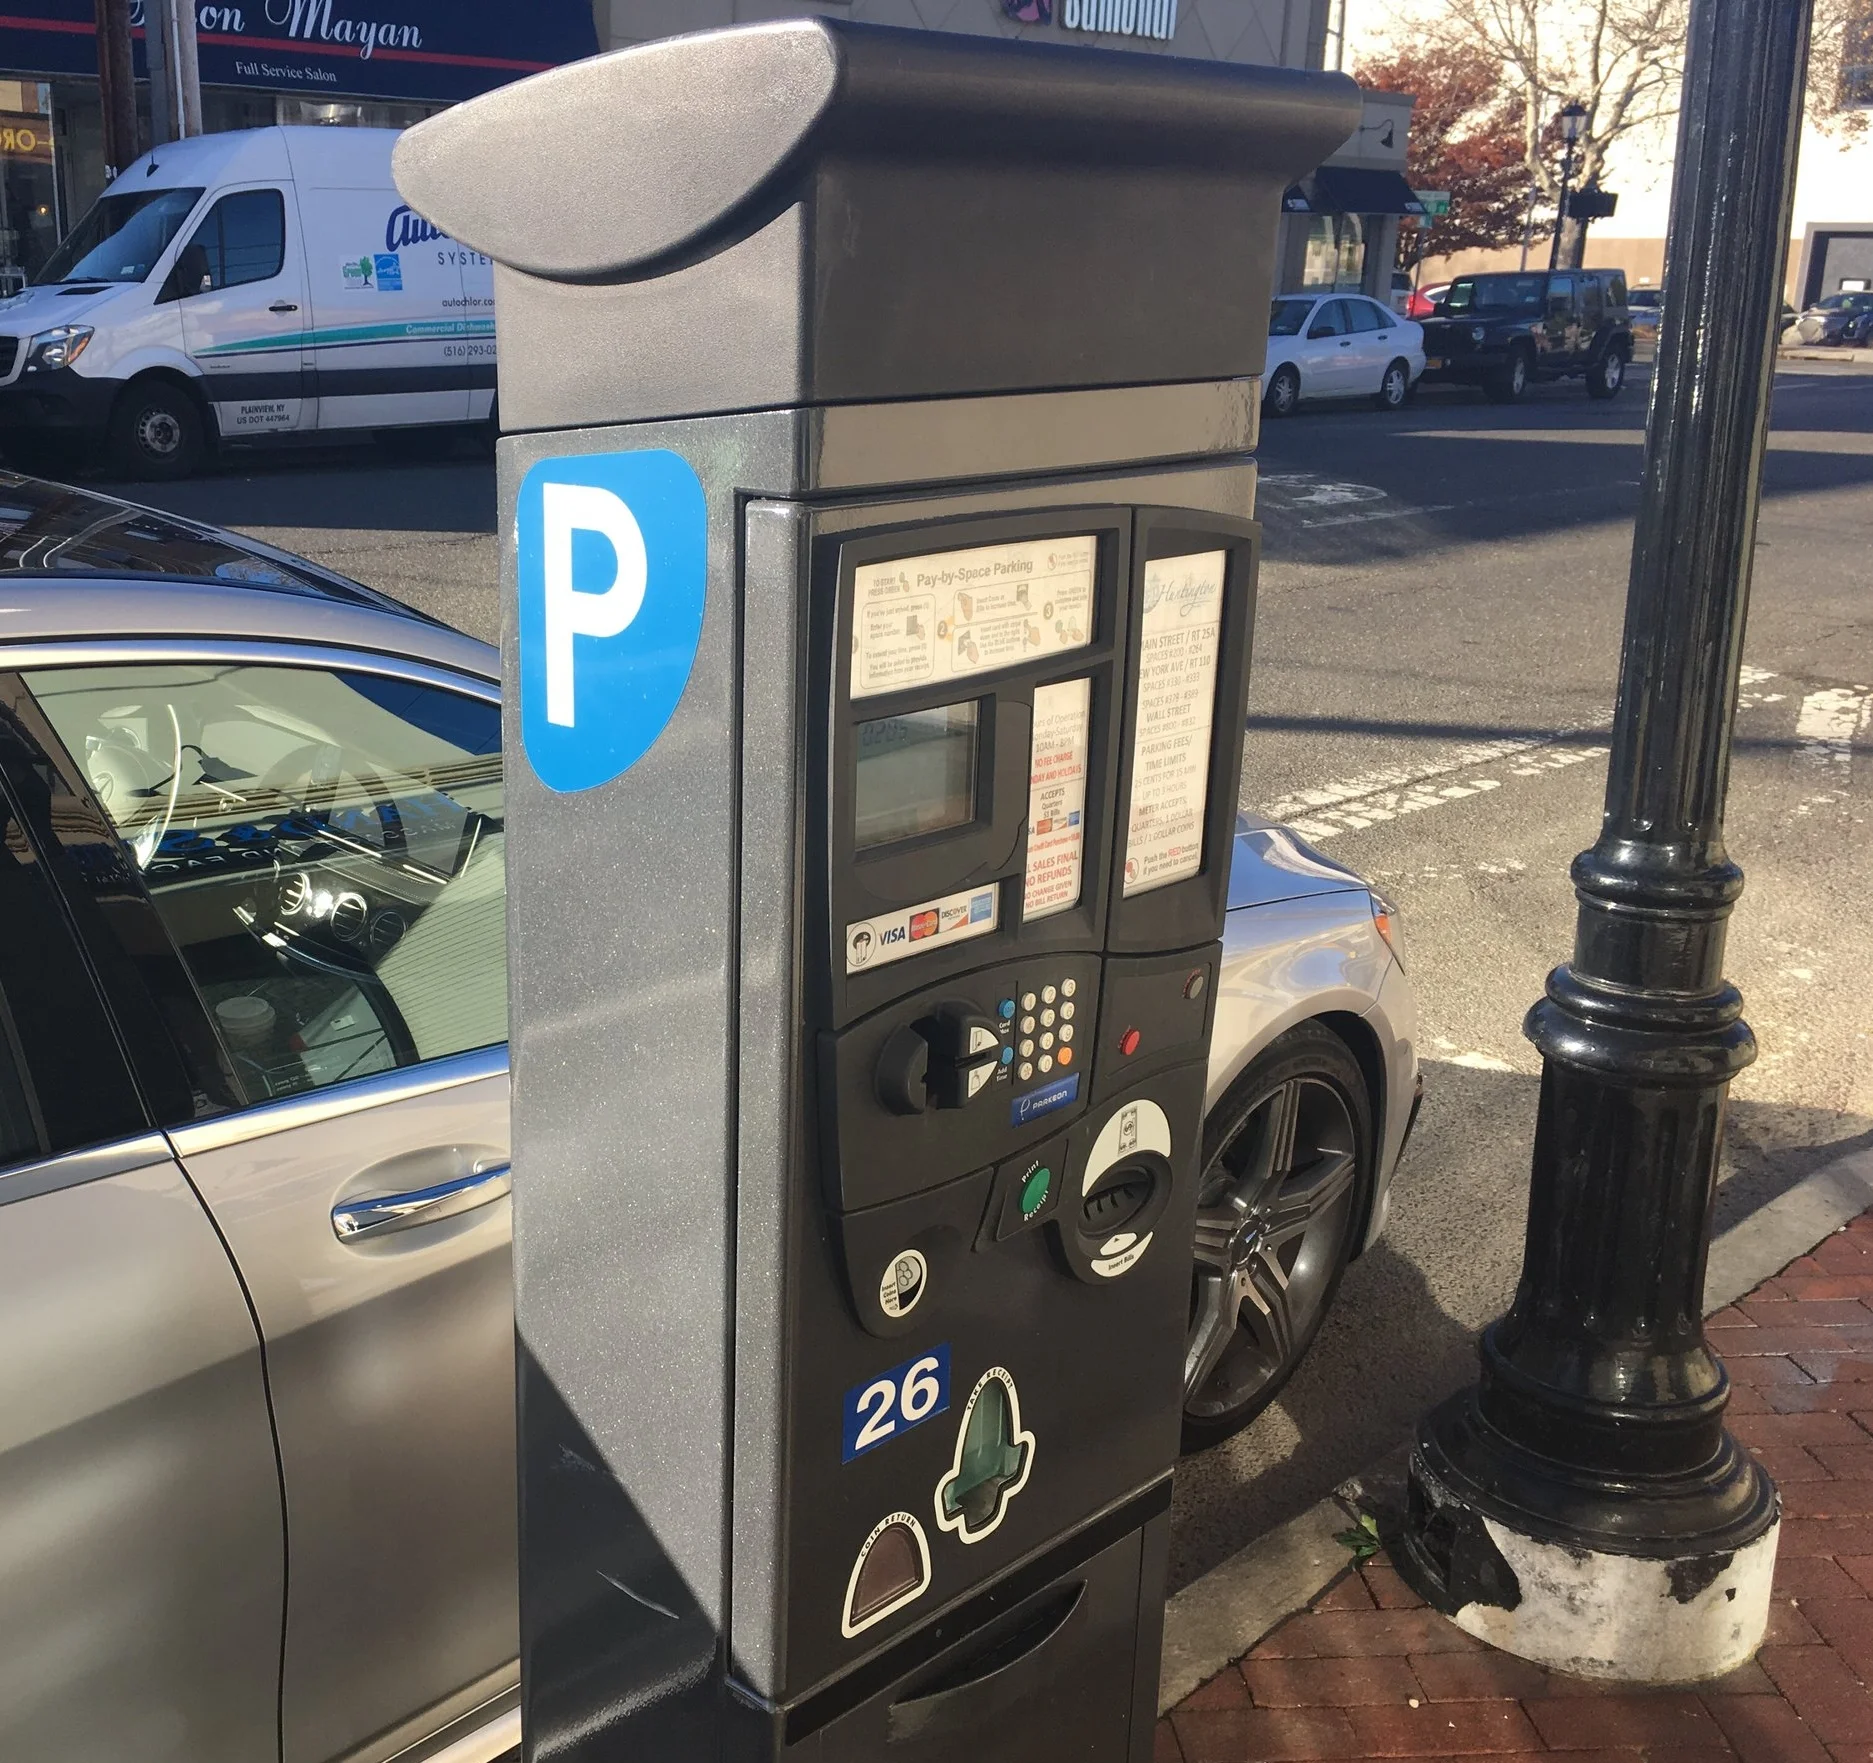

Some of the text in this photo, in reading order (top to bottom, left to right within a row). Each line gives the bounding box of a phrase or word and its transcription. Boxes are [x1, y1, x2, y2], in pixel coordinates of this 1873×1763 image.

[265, 0, 423, 60] Mayan
[235, 61, 337, 83] Full Service Salon
[405, 322, 455, 335] Commercial
[443, 346, 466, 357] (516)
[276, 403, 286, 412] NY
[236, 417, 248, 425] US
[248, 415, 264, 424] DOT
[917, 559, 1034, 588] Pay-by-Space Parking
[543, 482, 648, 728] P
[1160, 579, 1217, 618] Huntington
[1159, 632, 1185, 649] STREET
[1191, 629, 1201, 642] RT
[1201, 626, 1216, 640] 25A
[1146, 649, 1168, 664] SPACES
[1150, 662, 1170, 677] YORK
[1170, 660, 1184, 673] AVE
[1190, 657, 1199, 669] RT
[1199, 654, 1212, 667] 110
[1144, 678, 1166, 693] SPACES
[1142, 694, 1165, 710] SPACES
[1046, 714, 1055, 727] of
[1054, 709, 1086, 726] Operation
[1146, 703, 1192, 723] WALL STREET
[1139, 724, 1161, 737] SPACES
[1036, 740, 1056, 754] 10AM
[1141, 733, 1193, 756] PARKING FEES/
[1035, 750, 1074, 769] NO FEE CHARGE
[1145, 751, 1187, 773] TIME LIMITS
[1046, 769, 1058, 781] AND
[1056, 763, 1083, 778] HOLIDAYS
[1142, 772, 1162, 786] CENTS
[1162, 769, 1176, 781] FOR
[1176, 766, 1184, 778] 15
[1040, 786, 1066, 801] ACCEPTS
[1142, 788, 1152, 801] UP
[1152, 786, 1161, 798] TO
[1166, 779, 1188, 793] HOURS
[1041, 799, 1064, 811] Quarters
[1138, 802, 1161, 817] METER
[1170, 807, 1194, 823] DOLLAR
[1128, 835, 1144, 850] BILLS
[1153, 826, 1178, 842] DOLLAR
[1177, 821, 1196, 835] COINS
[1032, 856, 1056, 872] SALES
[1056, 850, 1079, 866] FINAL
[1143, 843, 1199, 866] Push the RED button
[1037, 864, 1073, 885] REFUNDS
[1148, 864, 1159, 877] you
[1158, 860, 1173, 871] need
[1031, 884, 1055, 899] CHANGE
[1055, 879, 1073, 892] GIVEN
[1026, 890, 1069, 909] NO BILL RETURN
[941, 905, 967, 919] DISCOVER
[879, 926, 906, 946] VISA
[998, 1021, 1011, 1029] Card
[997, 1067, 1008, 1075] Add
[1032, 1090, 1068, 1110] PARKEON
[1021, 1160, 1039, 1183] Print
[1023, 1190, 1049, 1222] Receipt
[1108, 1254, 1135, 1271] Insert Bills
[882, 1281, 896, 1292] Insert
[883, 1289, 897, 1298] Coins
[966, 1368, 1014, 1411] TAKE RECEIPT
[854, 1355, 940, 1451] 26
[861, 1513, 916, 1557] COIN RETURN
